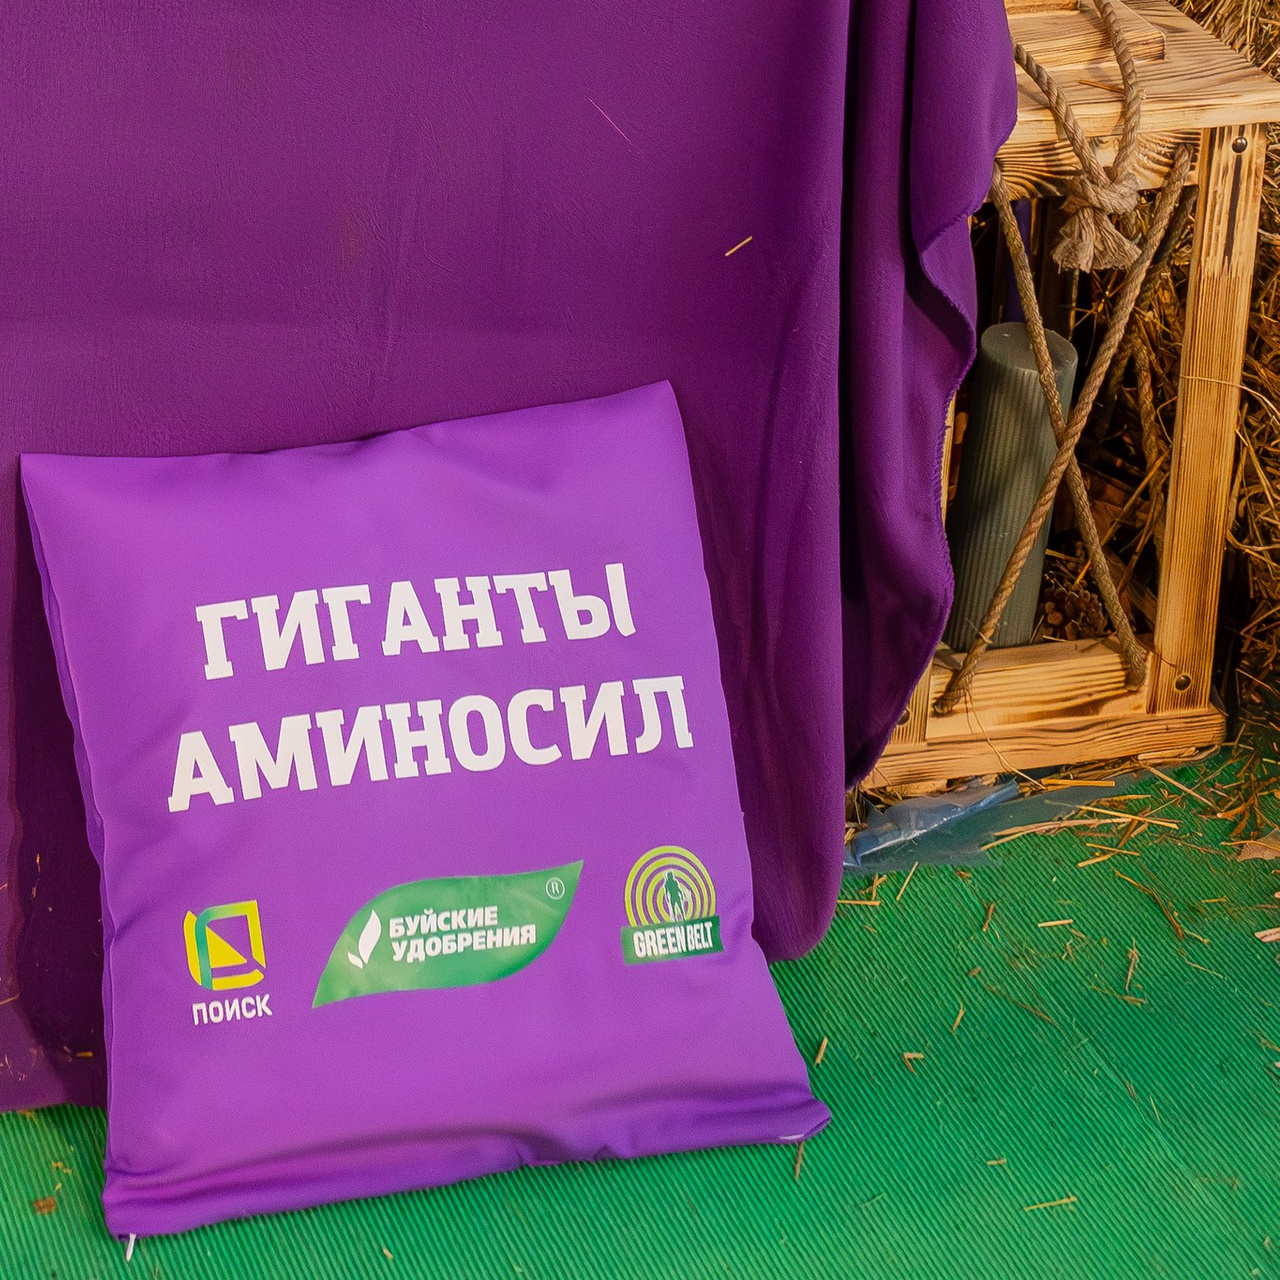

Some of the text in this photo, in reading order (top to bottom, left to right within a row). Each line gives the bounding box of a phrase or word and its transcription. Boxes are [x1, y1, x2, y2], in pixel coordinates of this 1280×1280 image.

[195, 563, 636, 679] ГИГАНТЫ
[167, 675, 694, 812] АМИНОСИЛ
[388, 904, 499, 940] БУЙСКИЕ
[391, 926, 536, 962] УДОБРЕНИЯ
[192, 993, 273, 1026] ПОИСК
